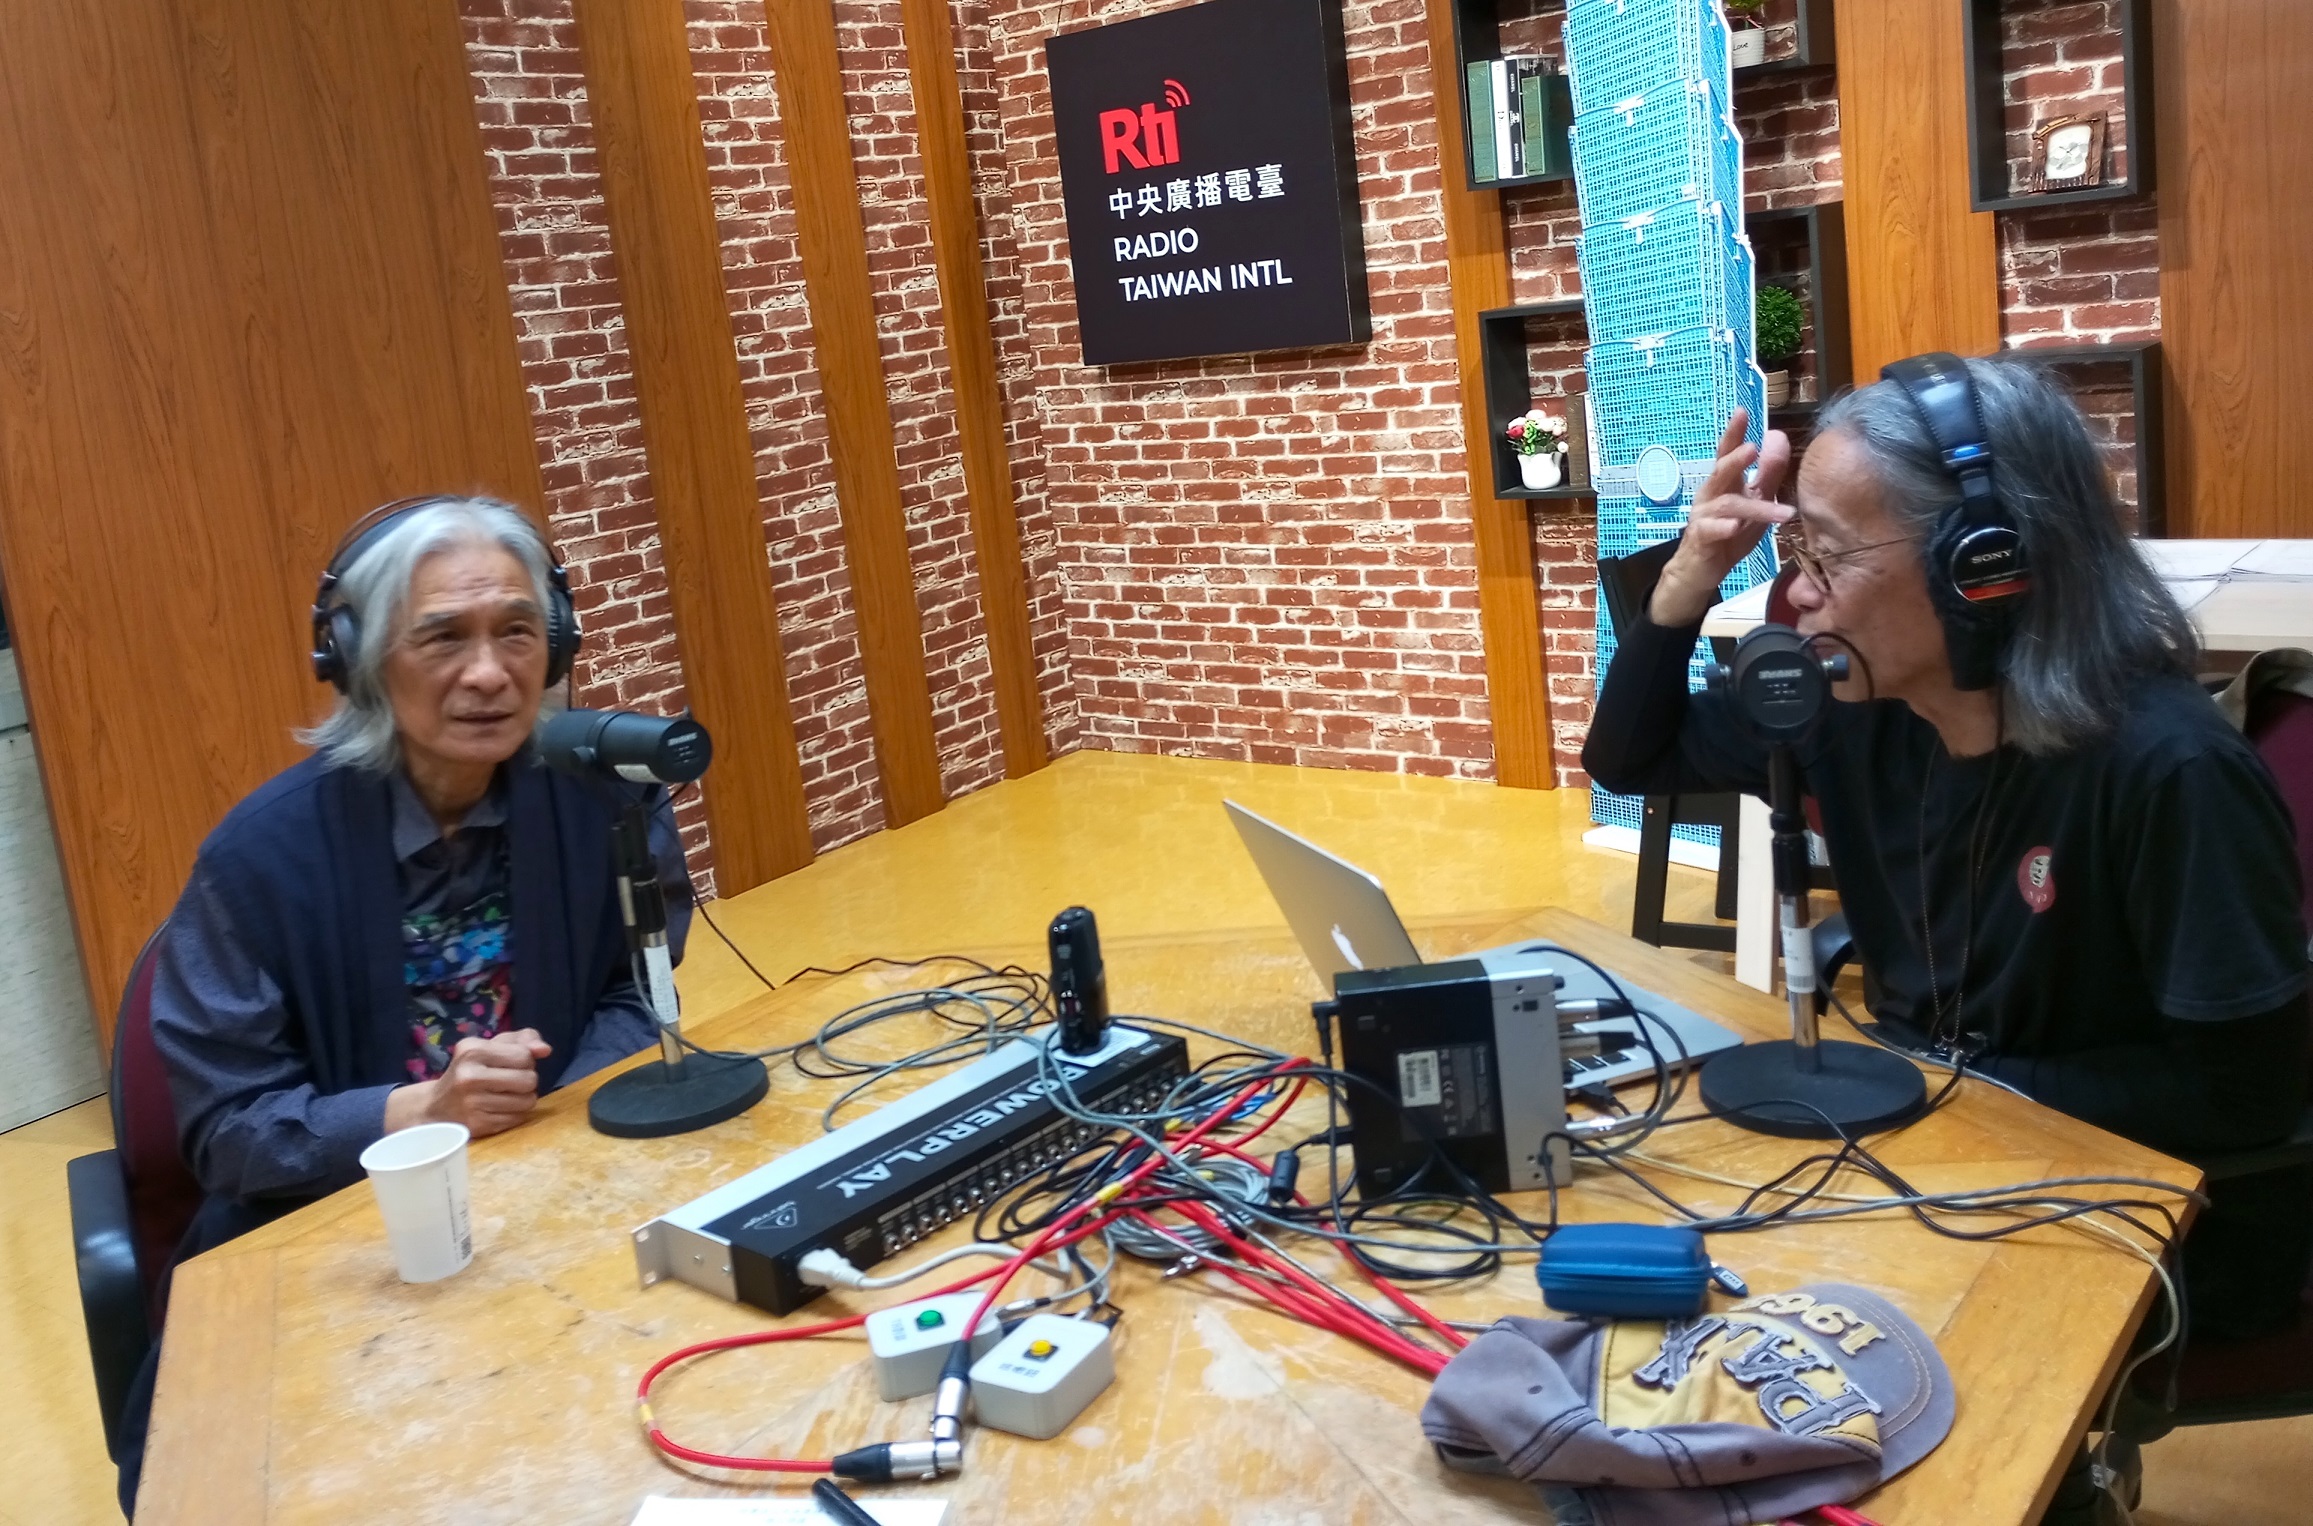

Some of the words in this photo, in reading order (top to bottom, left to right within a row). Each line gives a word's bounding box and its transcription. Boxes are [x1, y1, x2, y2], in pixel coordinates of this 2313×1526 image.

[1099, 101, 1182, 175] Rti
[1108, 162, 1286, 220] 中央廣播電臺
[1114, 226, 1199, 262] RADIO
[1118, 266, 1222, 302] TAIWAN
[1230, 258, 1293, 290] INTL
[1971, 549, 2013, 564] SONY
[836, 1066, 1089, 1198] POWERPLAY
